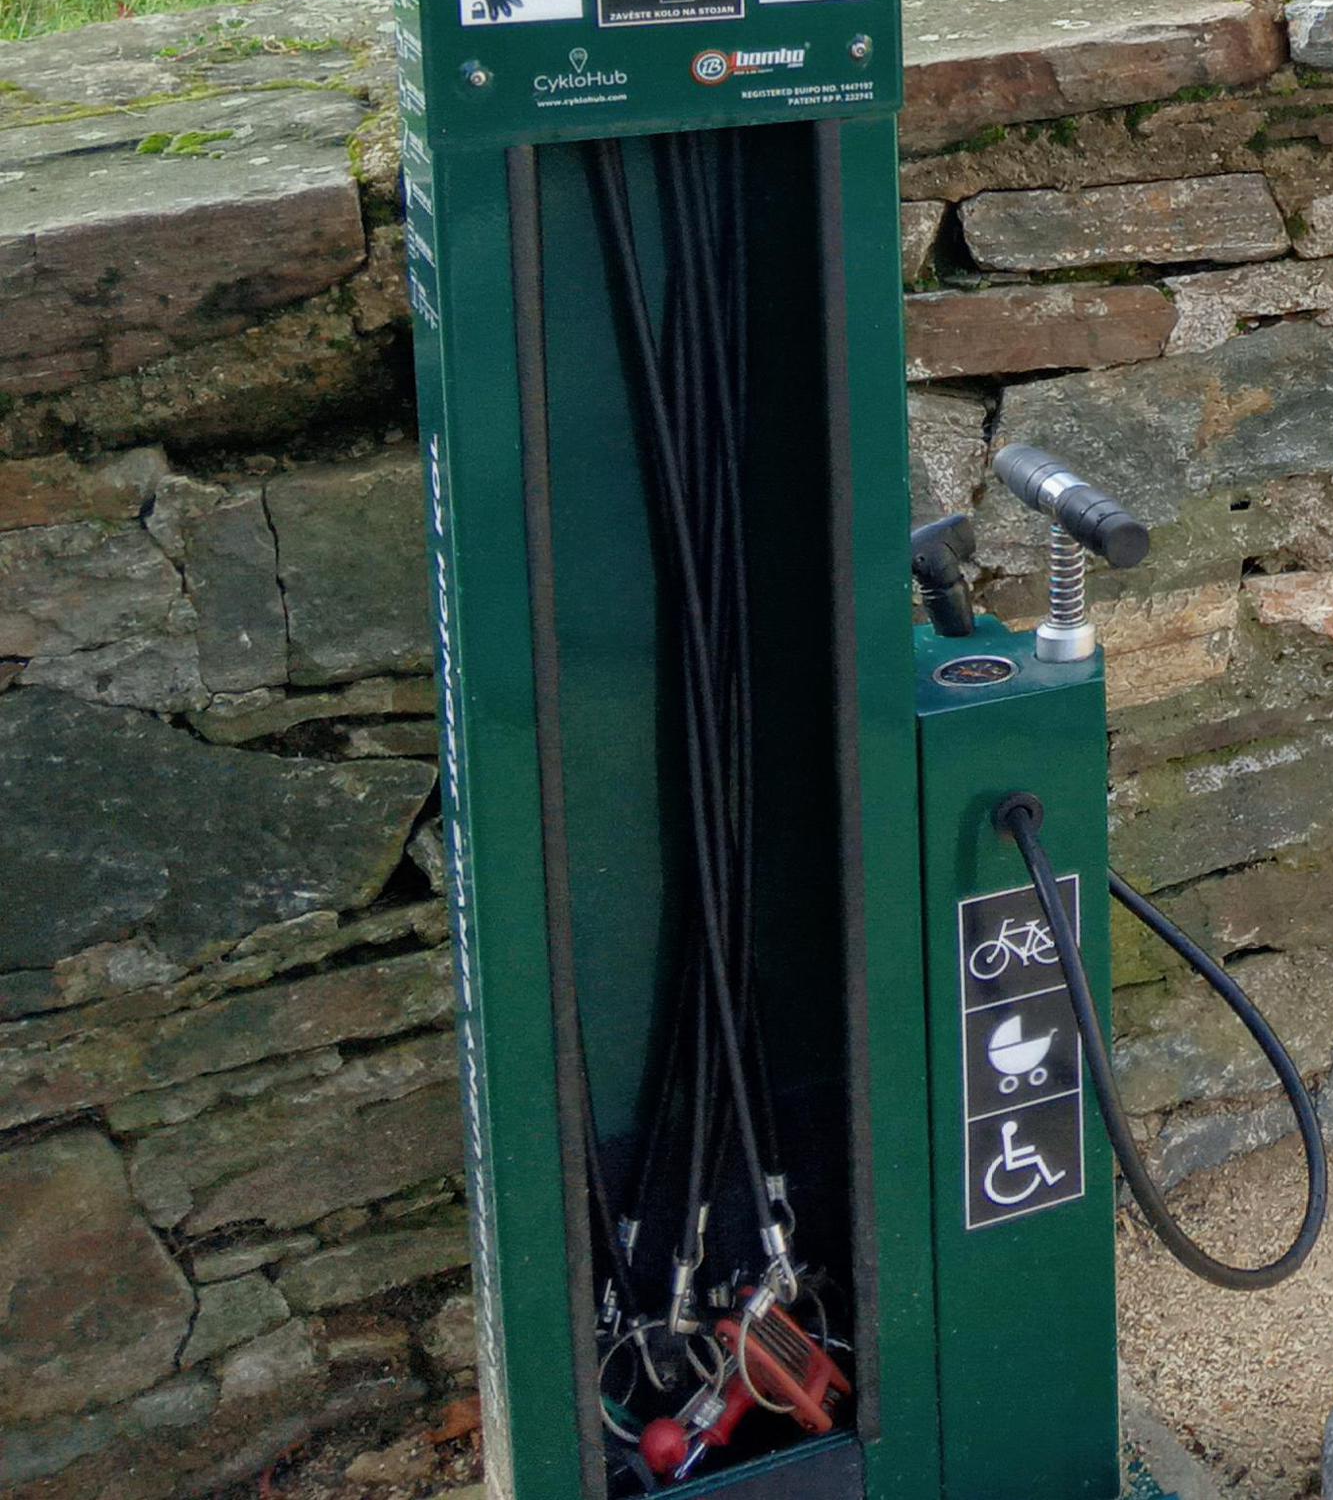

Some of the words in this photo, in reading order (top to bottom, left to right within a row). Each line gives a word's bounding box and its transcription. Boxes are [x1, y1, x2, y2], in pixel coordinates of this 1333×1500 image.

[610, 10, 651, 21] ZAVĚSTE
[654, 9, 680, 18] KOLO
[683, 8, 697, 16] NA
[698, 6, 735, 15] STOJAN
[534, 70, 627, 93] CykloHub
[431, 433, 443, 536] KOL
[452, 820, 473, 1011] SERVIS
